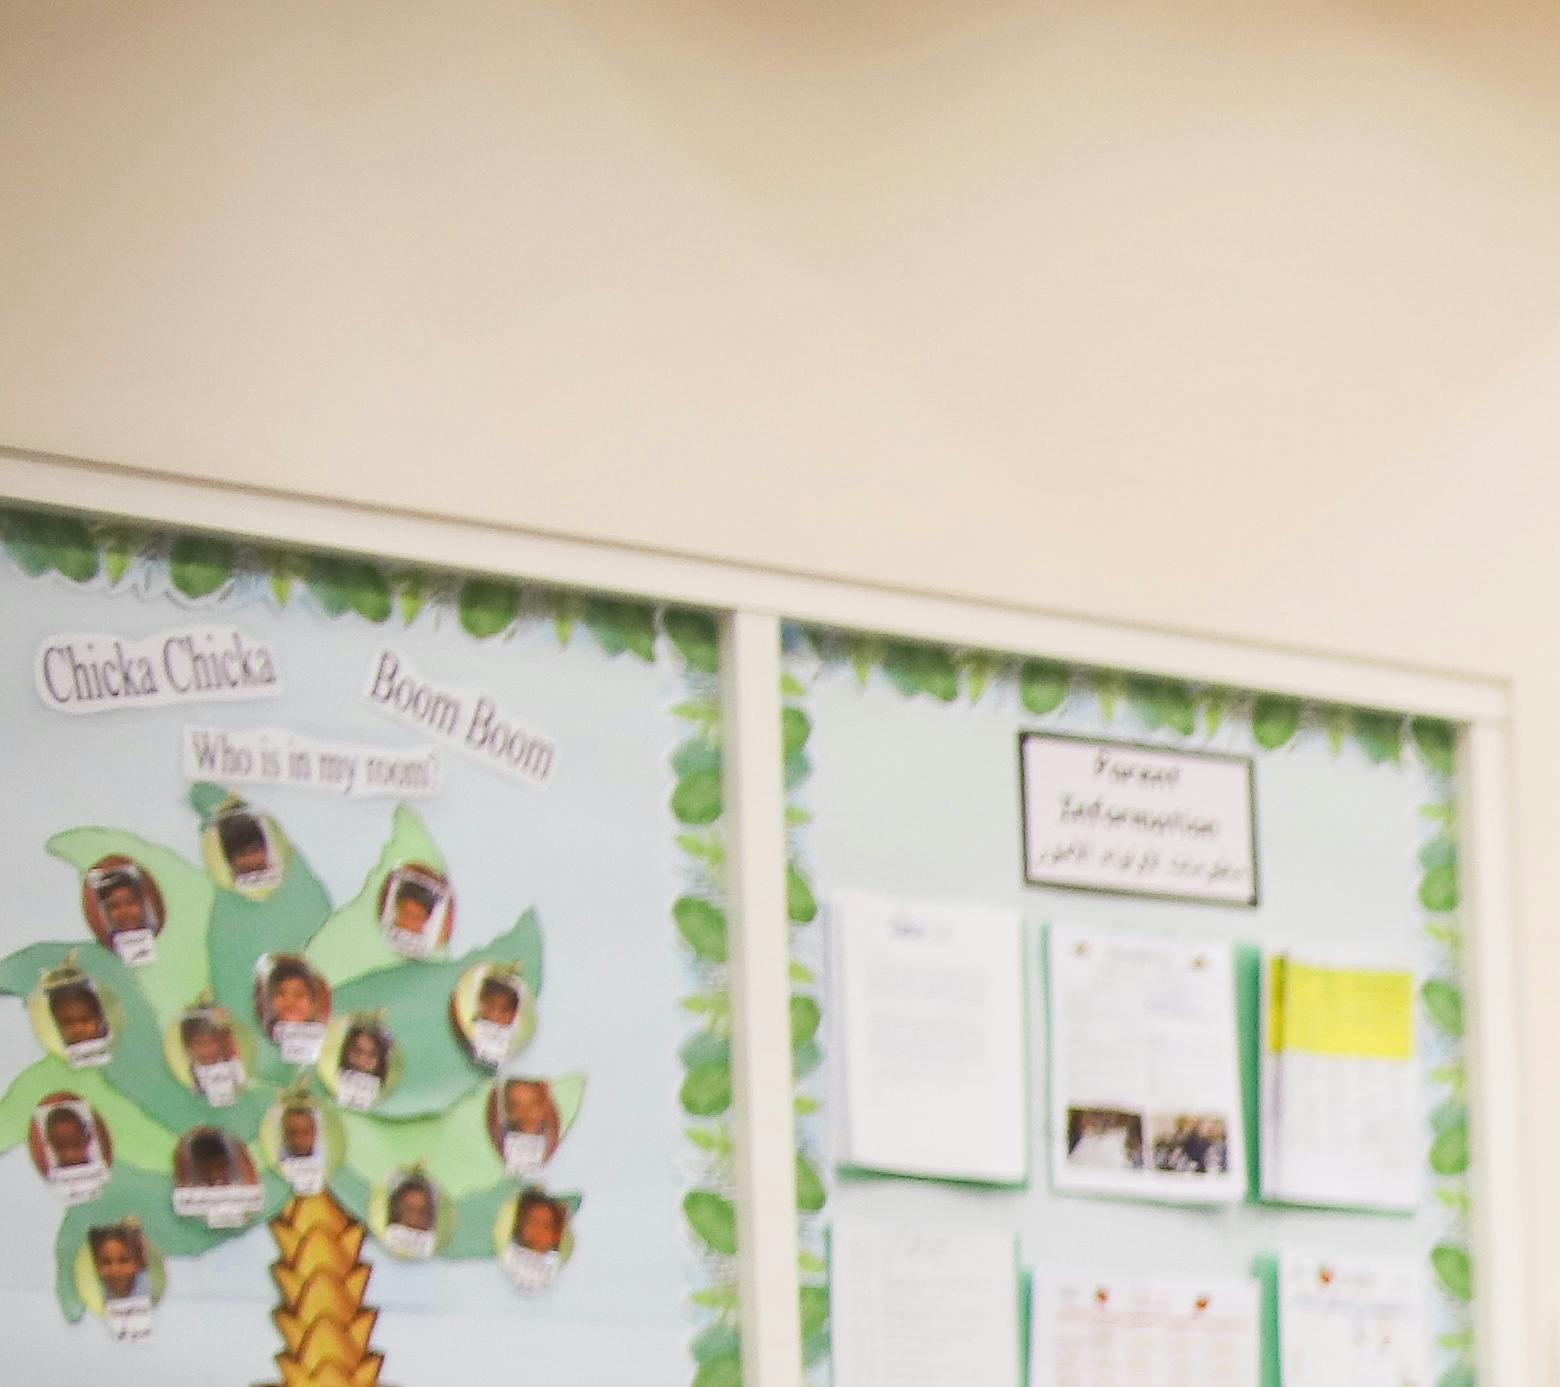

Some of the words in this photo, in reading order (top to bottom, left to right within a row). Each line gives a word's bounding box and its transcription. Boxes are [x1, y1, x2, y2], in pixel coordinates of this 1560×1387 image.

[42, 642, 157, 705] Chicka
[163, 633, 278, 695] Chicka
[370, 650, 462, 734] Boom
[464, 696, 557, 781] Boom
[192, 730, 253, 778] Who
[260, 736, 283, 780] is
[287, 734, 313, 783] in
[319, 751, 357, 796] my
[1057, 790, 1219, 838] Information
